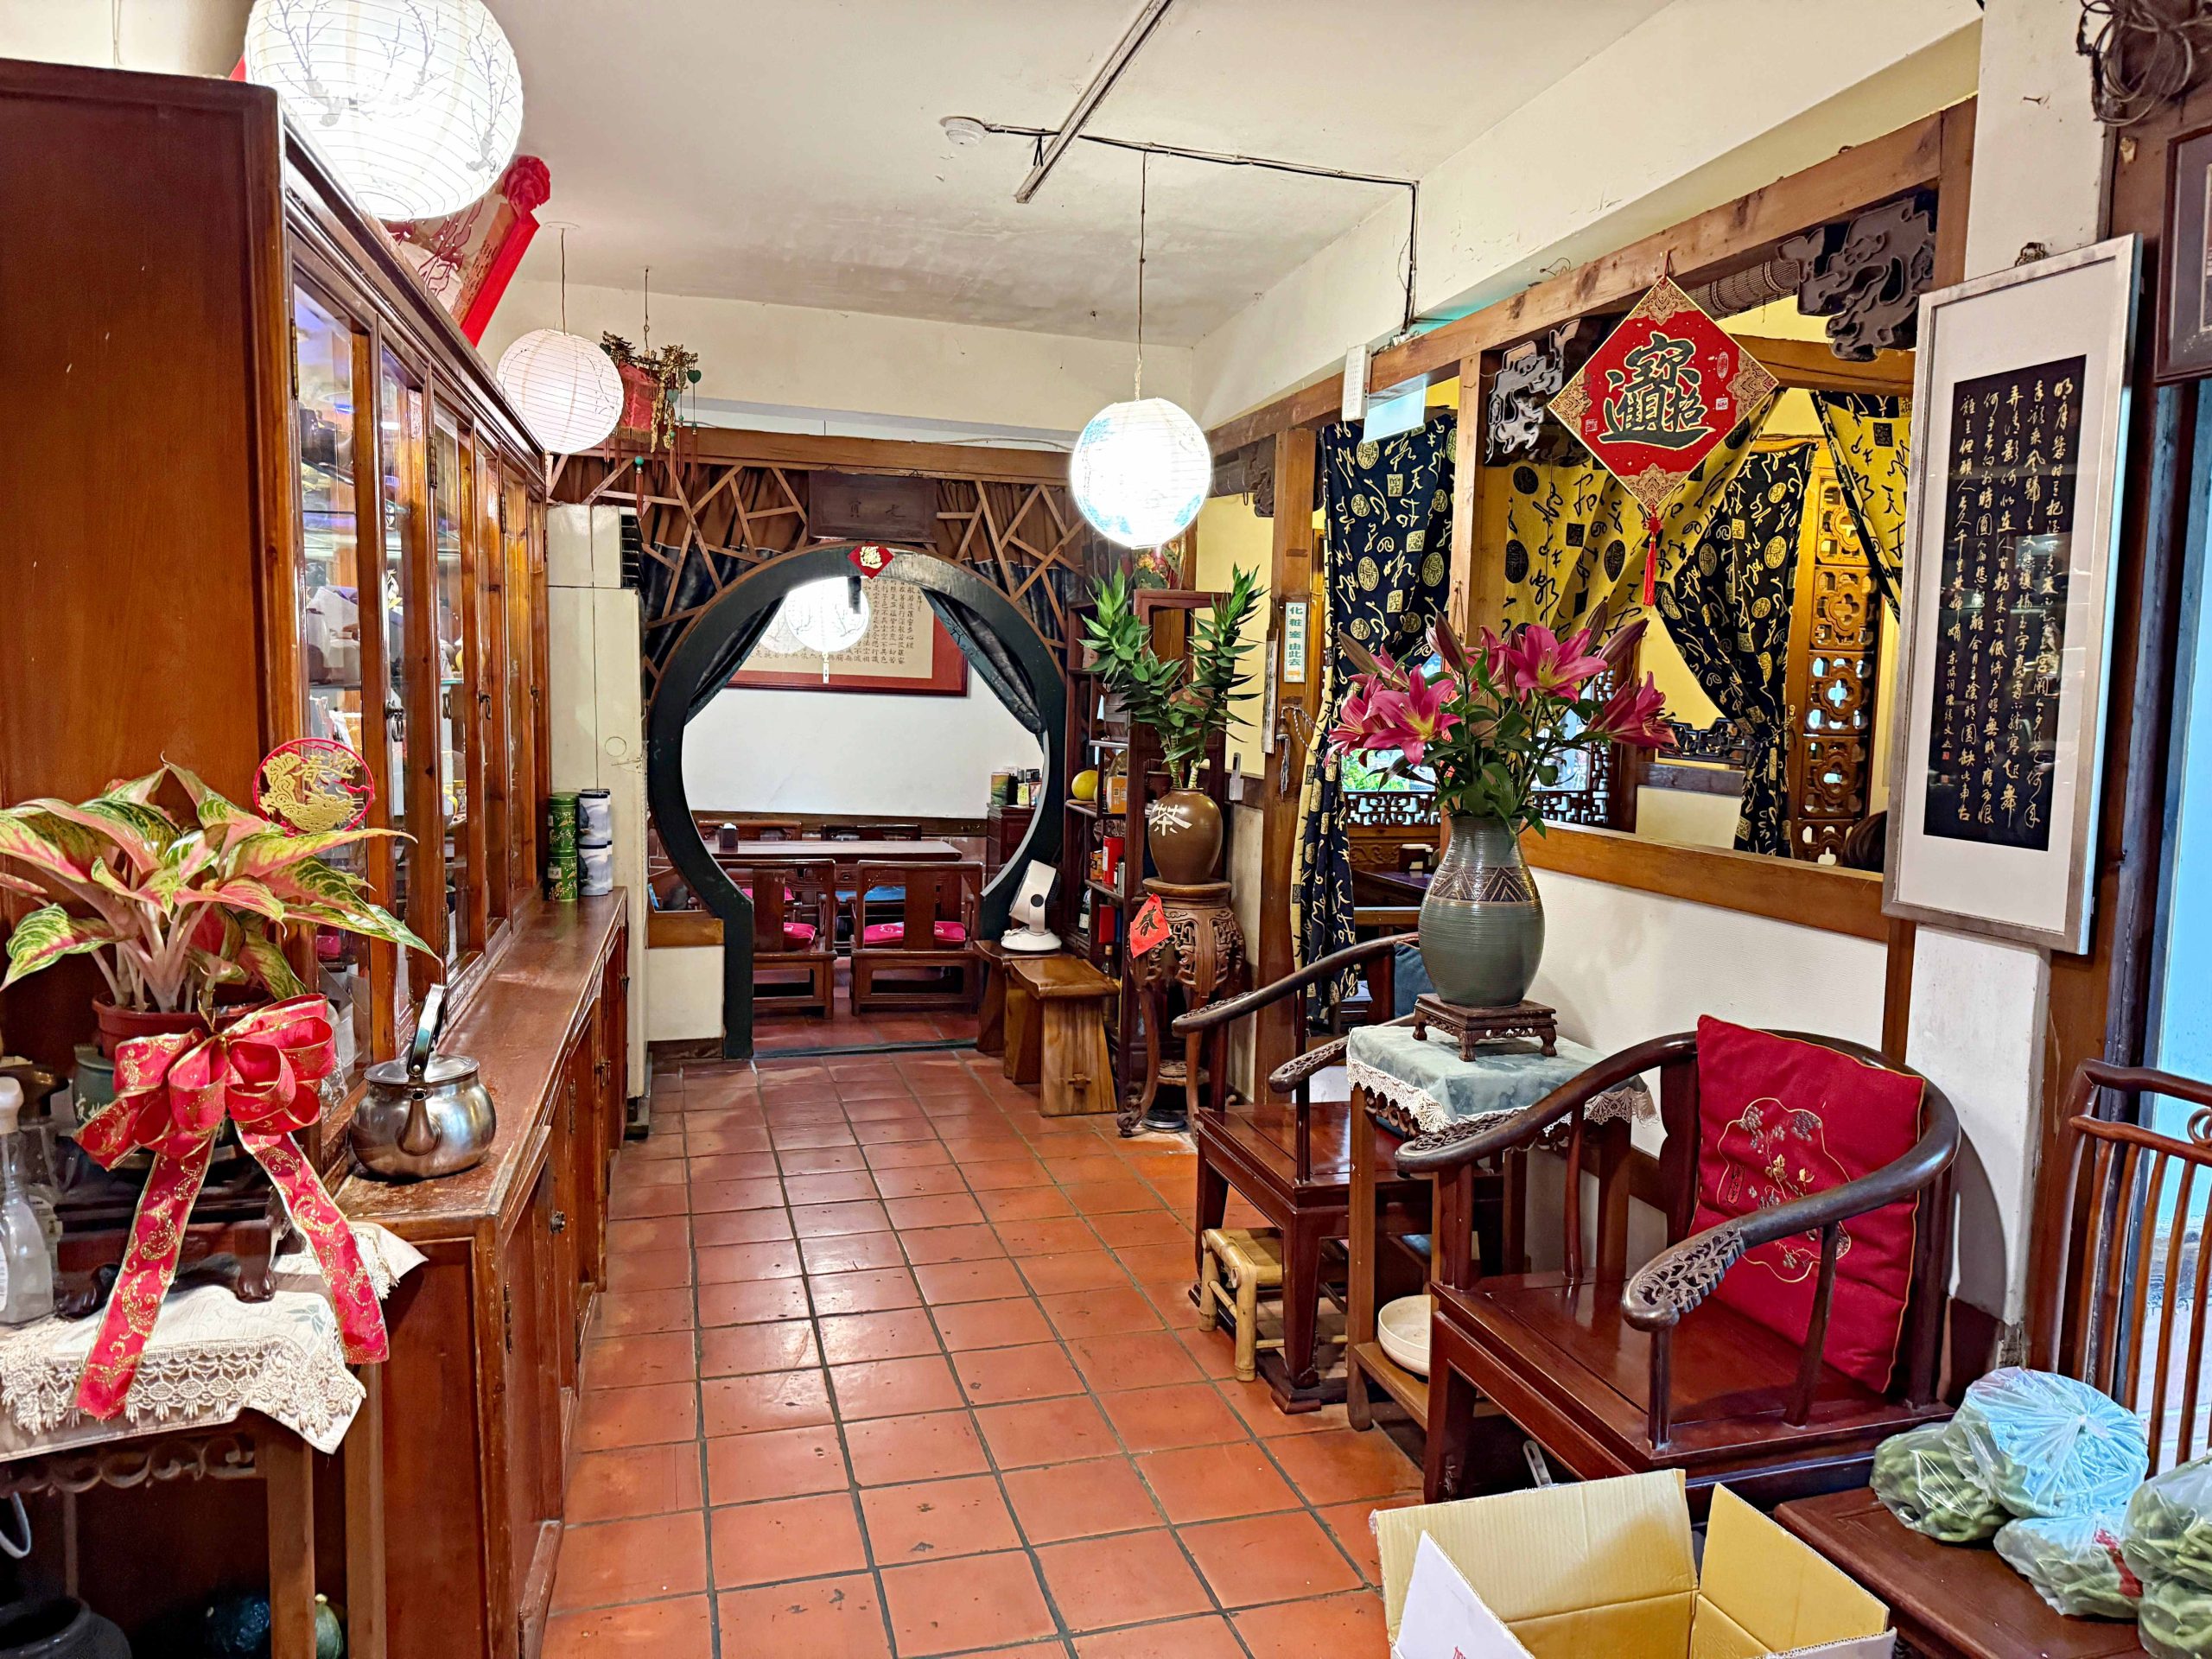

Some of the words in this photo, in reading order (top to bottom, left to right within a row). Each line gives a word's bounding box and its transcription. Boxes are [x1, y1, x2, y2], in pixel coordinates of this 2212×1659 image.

[1288, 607, 1303, 666] 化粧室由此去
[1149, 804, 1192, 836] 茶
